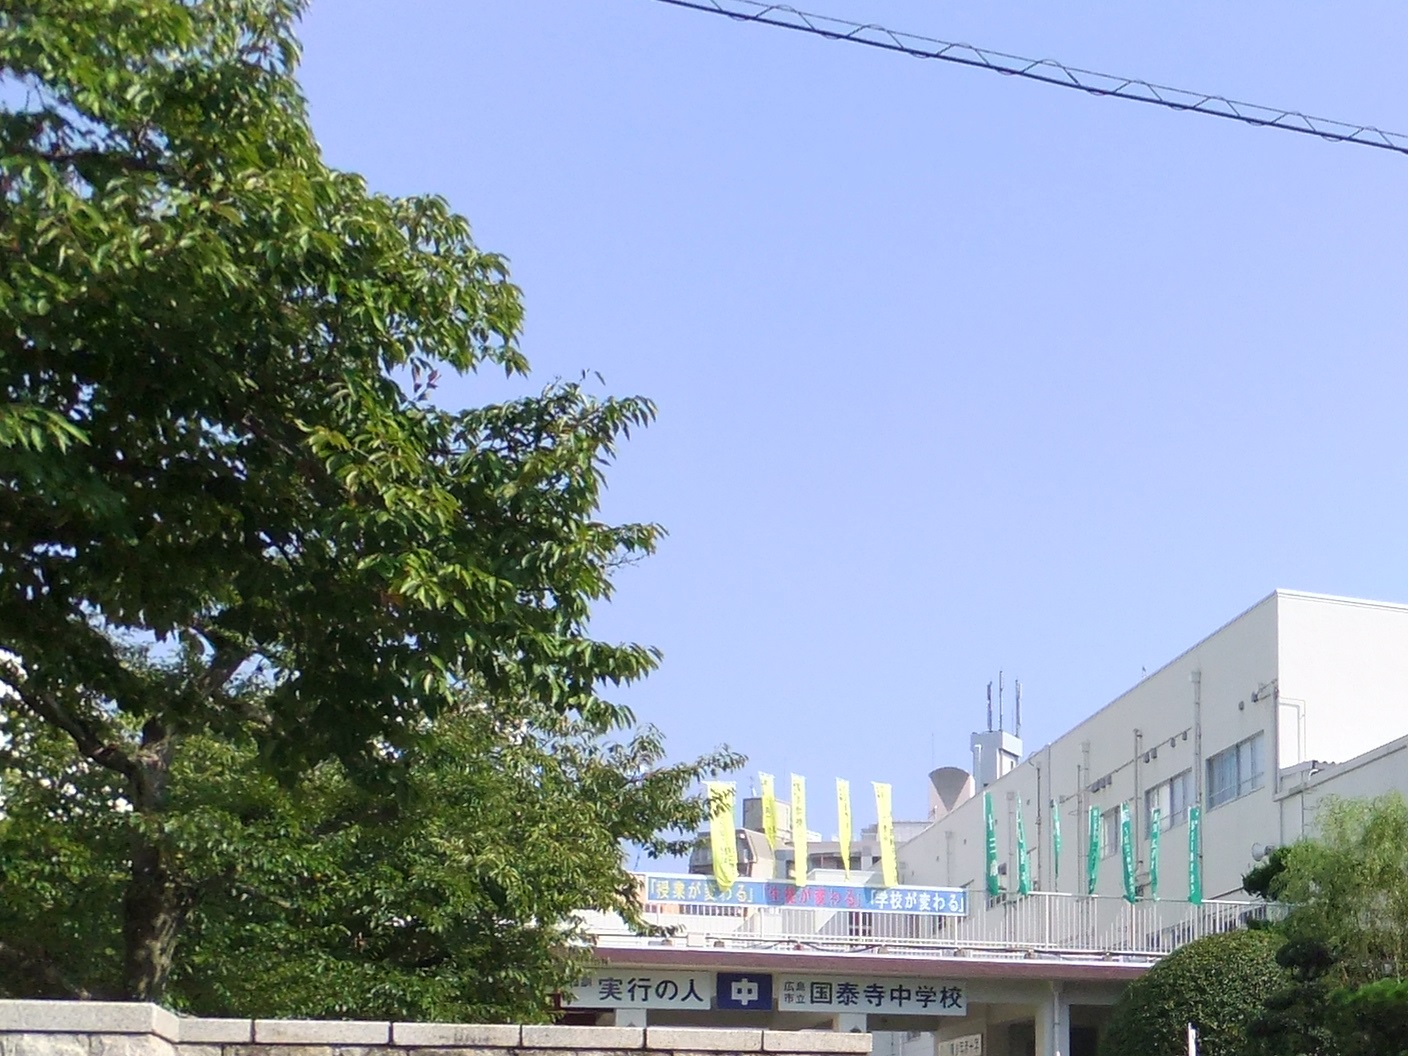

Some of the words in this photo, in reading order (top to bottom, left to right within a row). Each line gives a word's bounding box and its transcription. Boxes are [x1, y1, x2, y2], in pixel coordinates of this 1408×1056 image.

[599, 976, 704, 1002] 実行の人
[810, 981, 963, 1008] 国泰寺中学校
